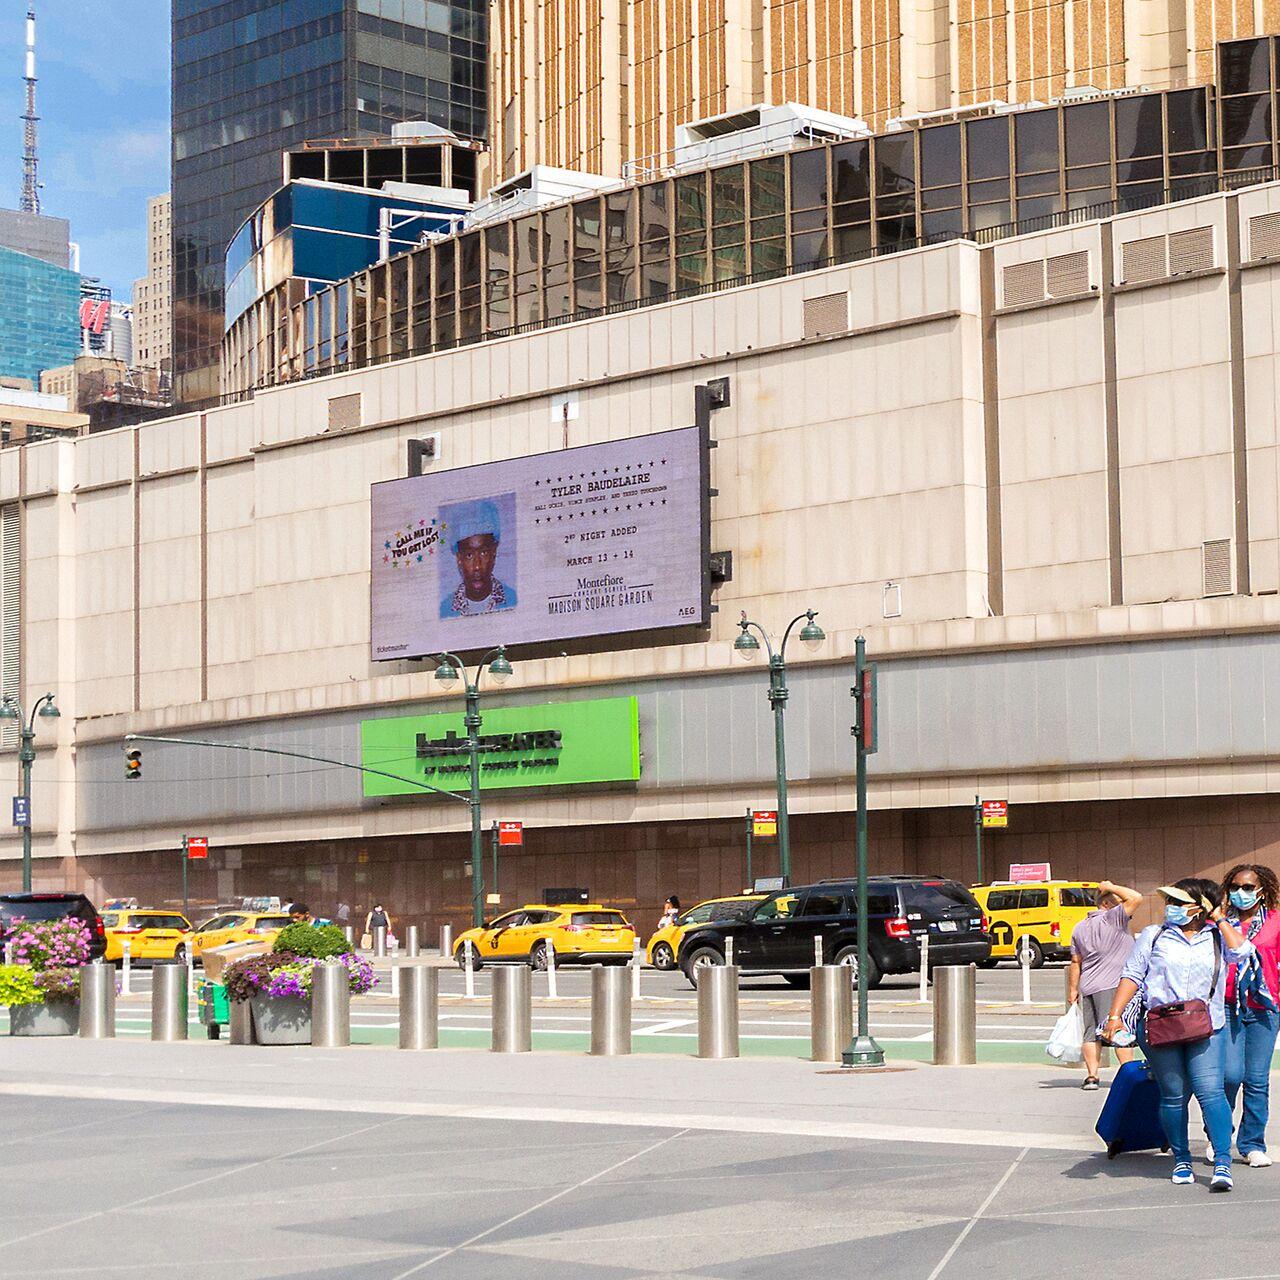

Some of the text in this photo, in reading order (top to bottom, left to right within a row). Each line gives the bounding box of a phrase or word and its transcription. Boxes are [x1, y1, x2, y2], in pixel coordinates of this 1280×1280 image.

[551, 473, 650, 498] TYLER BAUDELAIRE
[396, 533, 413, 548] CALL
[413, 528, 424, 539] ME
[580, 531, 606, 542] NIGHT
[611, 525, 638, 537] ADDED
[392, 531, 440, 558] YOU GET LOST
[566, 555, 593, 567] MARCH
[598, 553, 608, 563] 13
[624, 549, 634, 559] 14
[577, 574, 624, 590] Montefiore
[548, 590, 653, 615] MADISON SQUARE GARDEN
